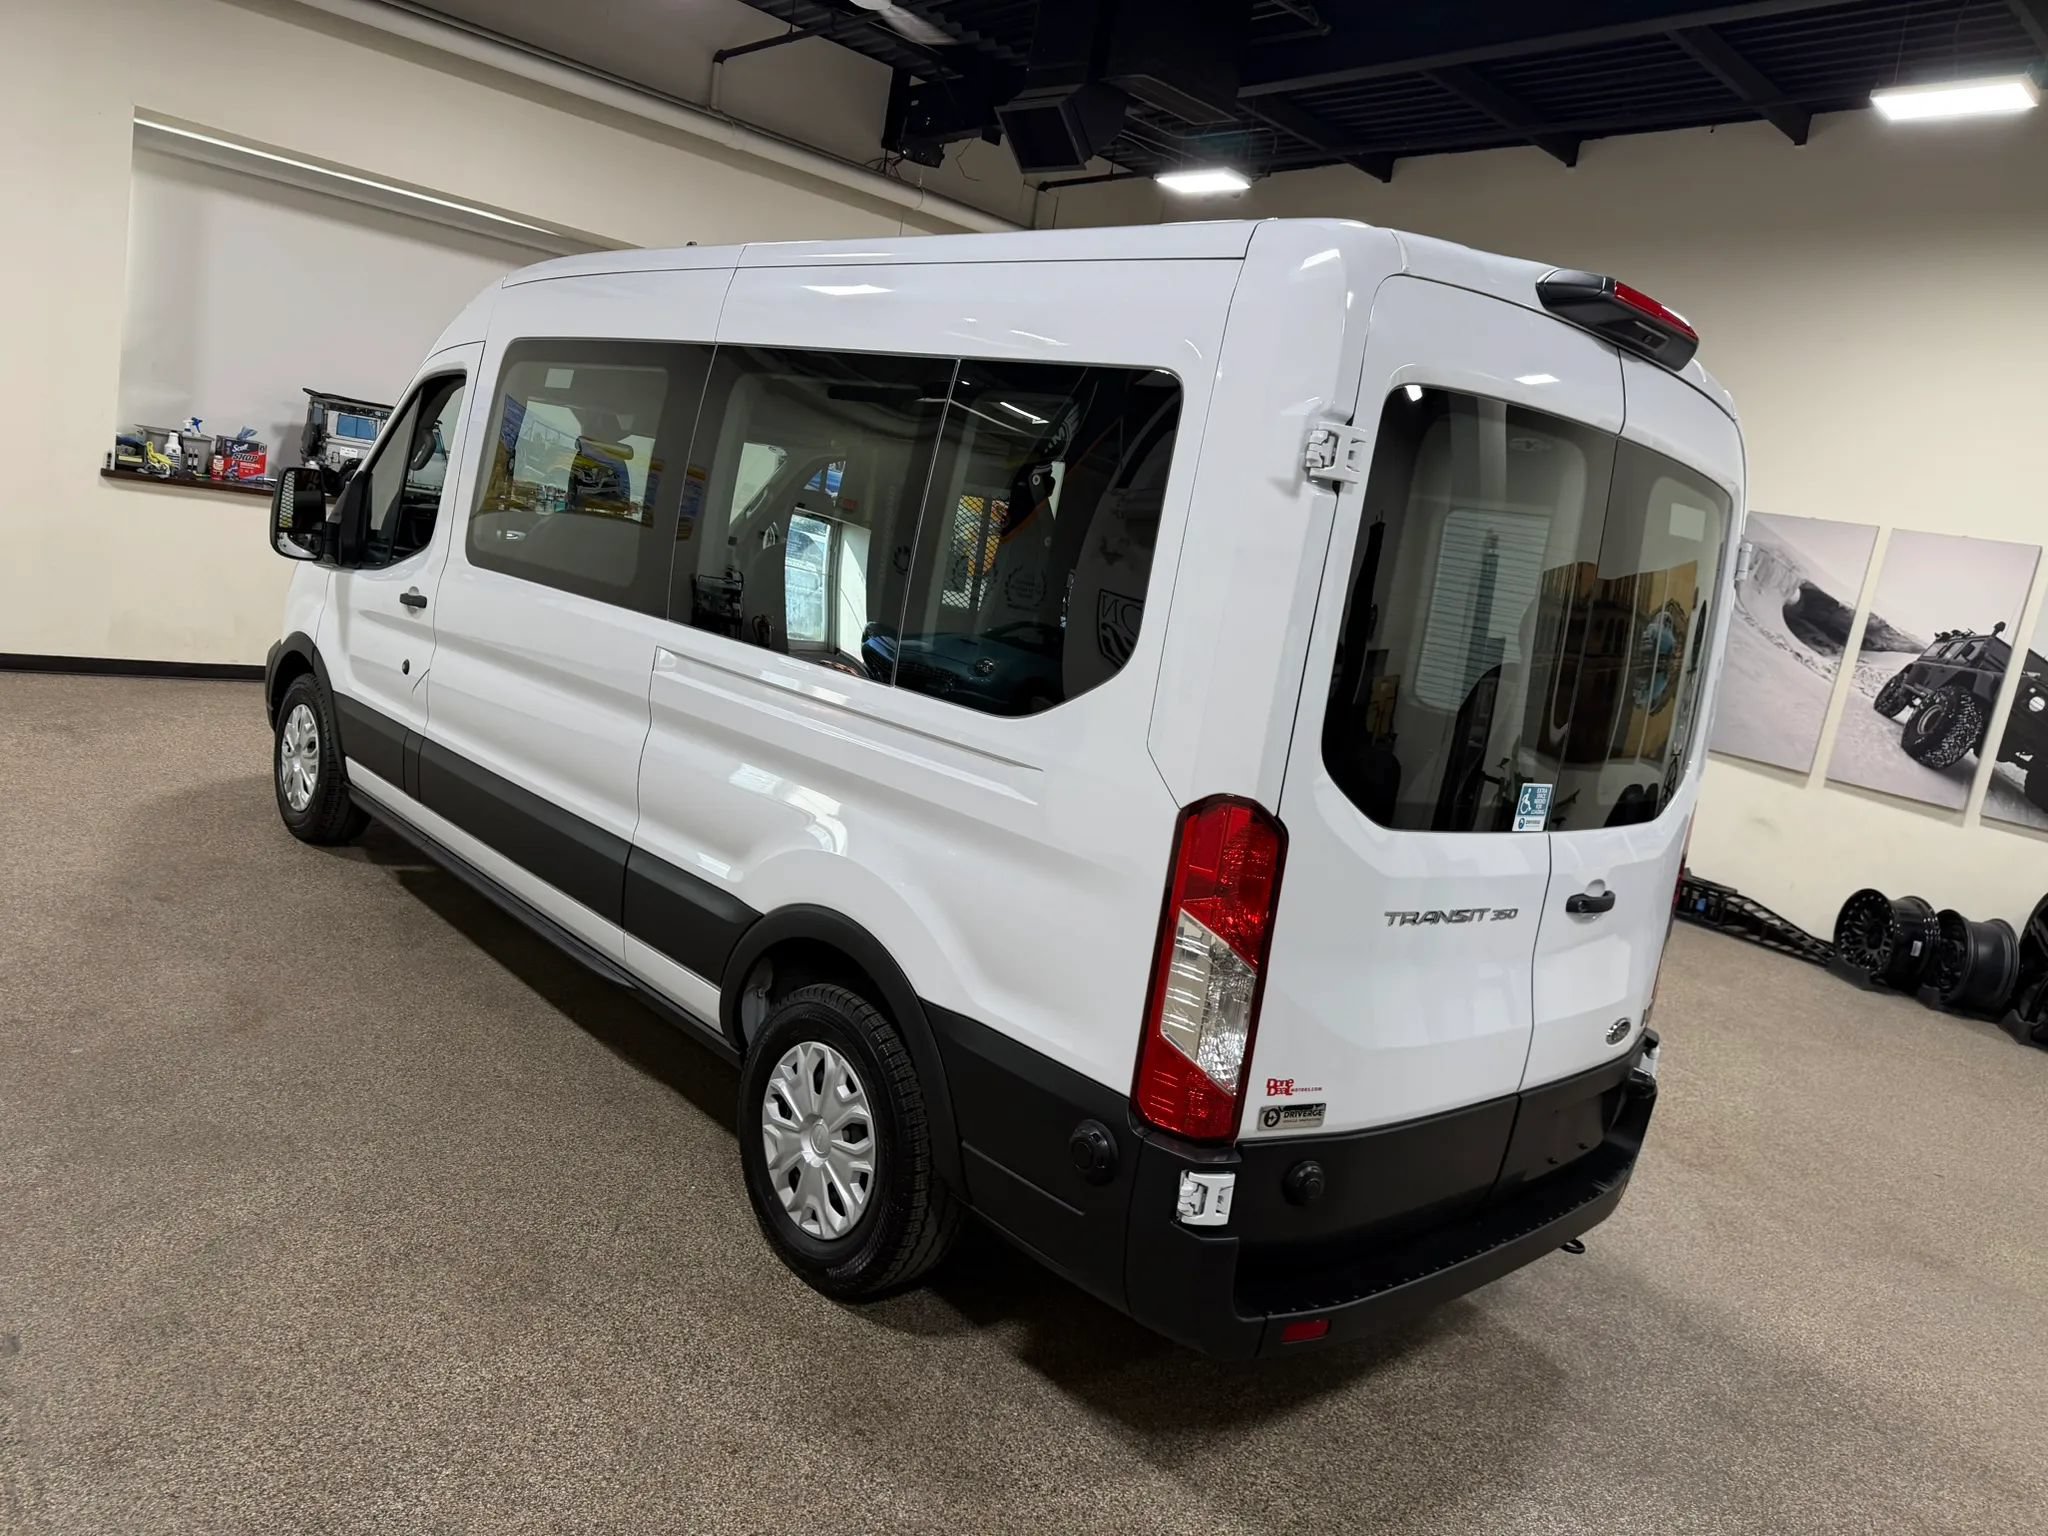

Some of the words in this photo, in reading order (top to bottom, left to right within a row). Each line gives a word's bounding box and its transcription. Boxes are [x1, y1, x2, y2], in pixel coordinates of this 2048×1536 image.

[232, 453, 259, 462] SHOP
[1384, 908, 1491, 926] TRANSIT
[1490, 908, 1519, 921] 350
[1283, 1110, 1323, 1118] DRIVERGE
